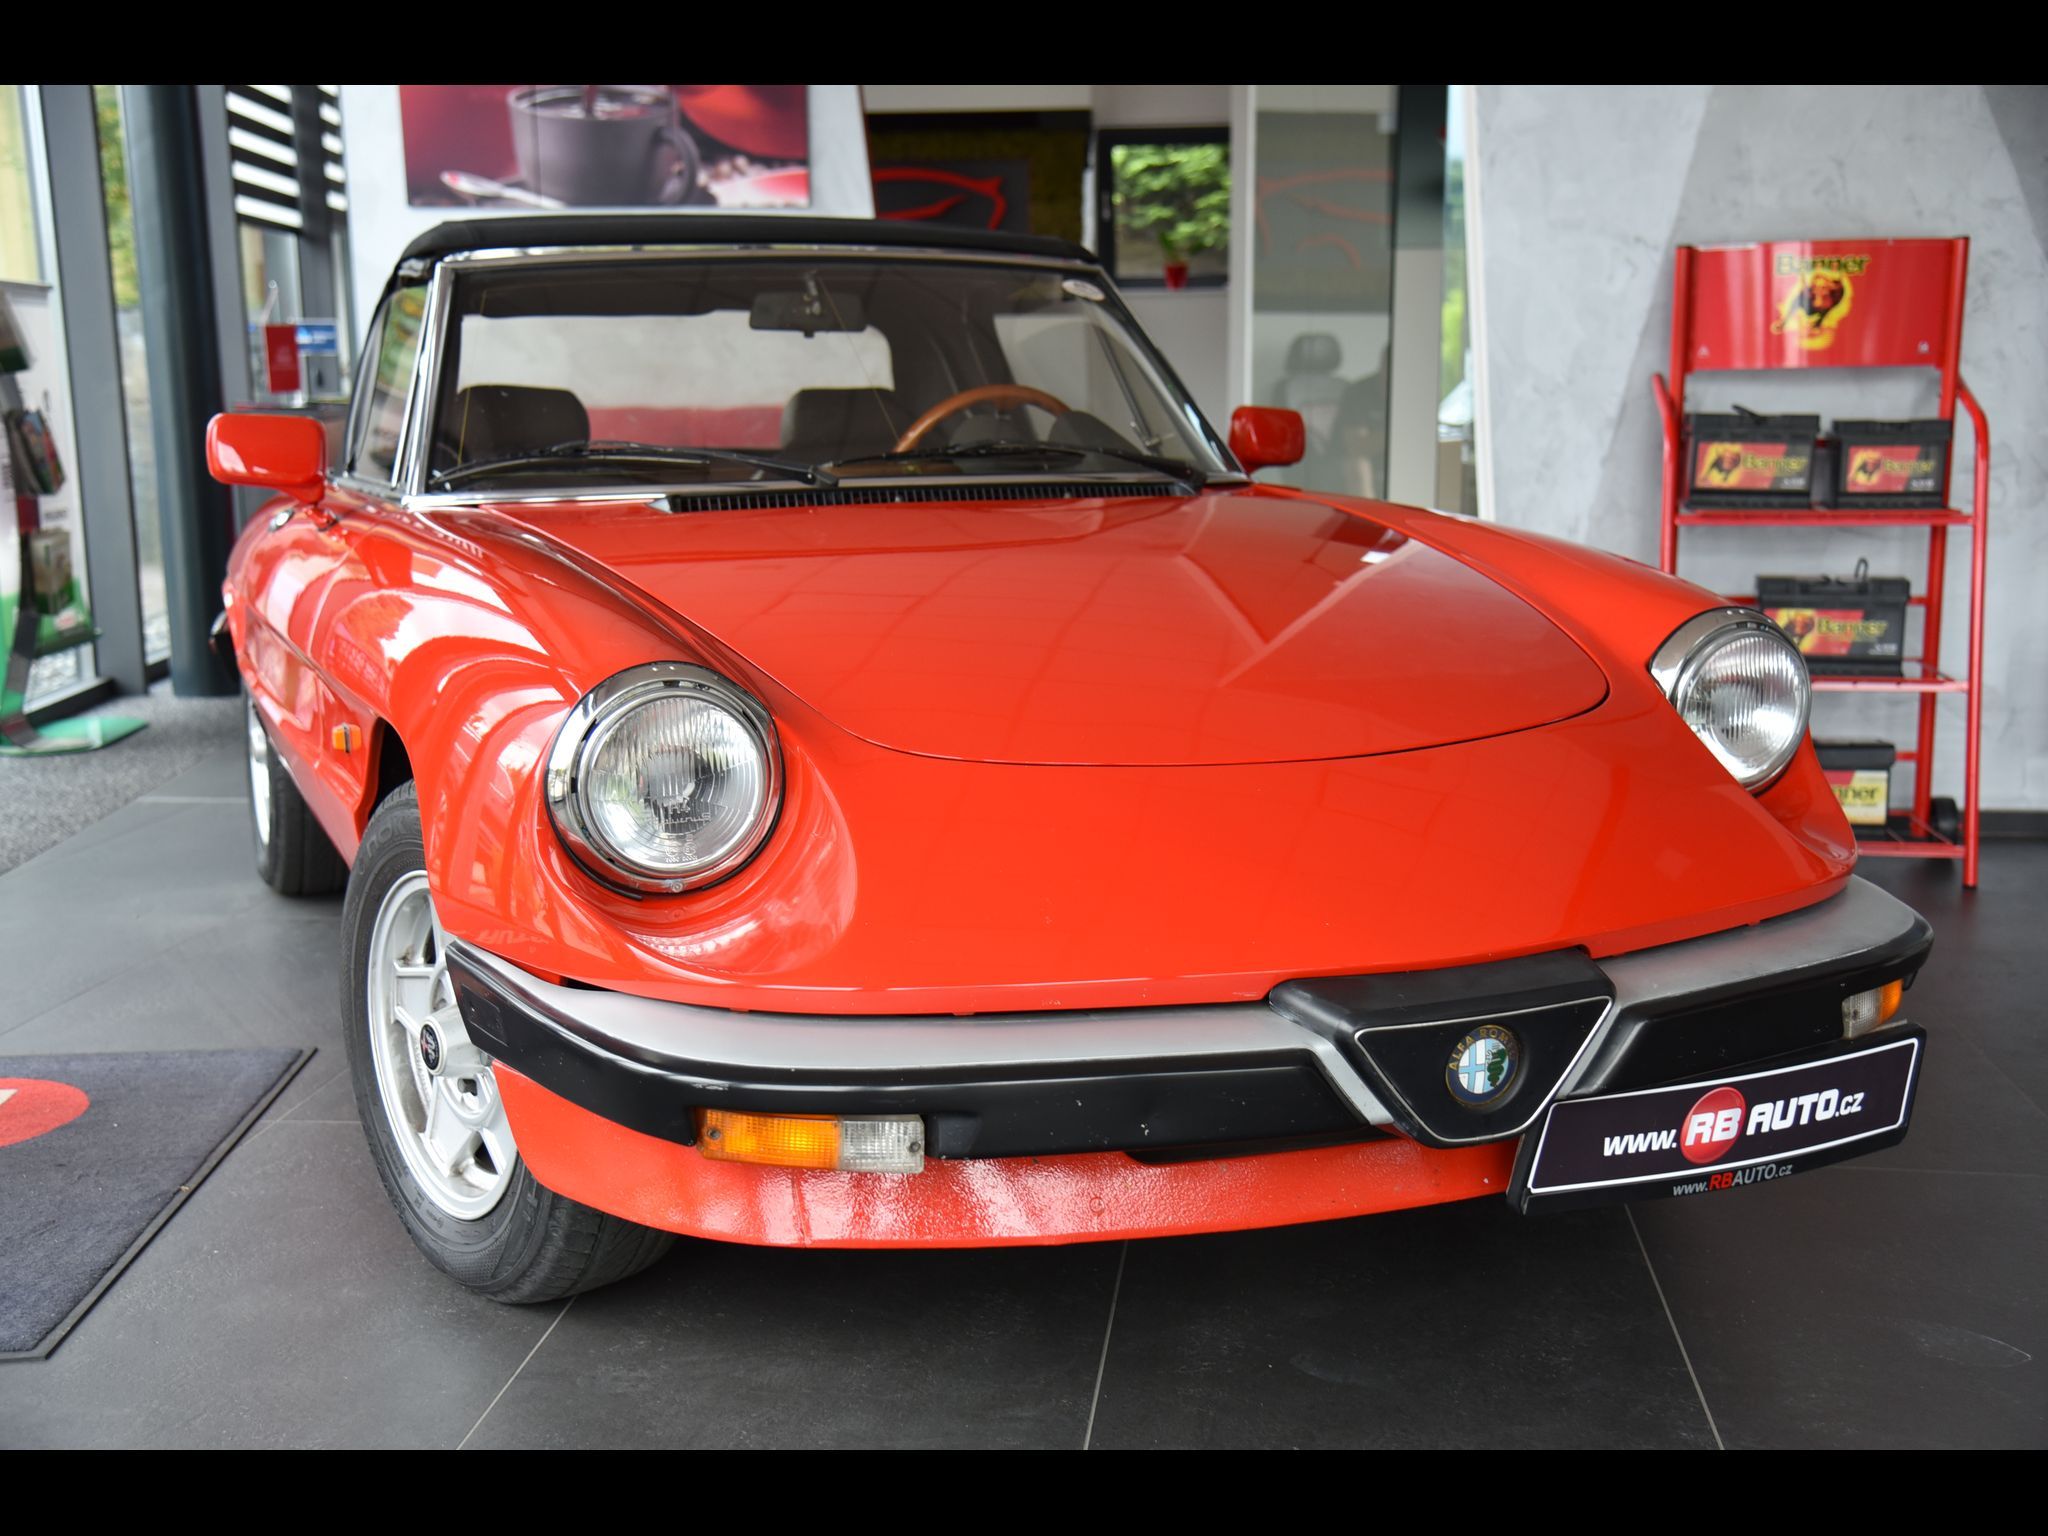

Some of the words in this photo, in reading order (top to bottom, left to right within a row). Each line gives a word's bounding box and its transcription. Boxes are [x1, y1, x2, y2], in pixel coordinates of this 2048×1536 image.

[1776, 255, 1870, 275] Banner
[1817, 618, 1888, 638] Banner
[1832, 785, 1879, 801] nner
[1448, 1035, 1475, 1070] ALFA
[1603, 1130, 1677, 1156] www.
[1685, 1107, 1742, 1146] RB
[1746, 1088, 1865, 1135] AUTO.cz
[1672, 1163, 1793, 1196] www.RBAUTO.cz
